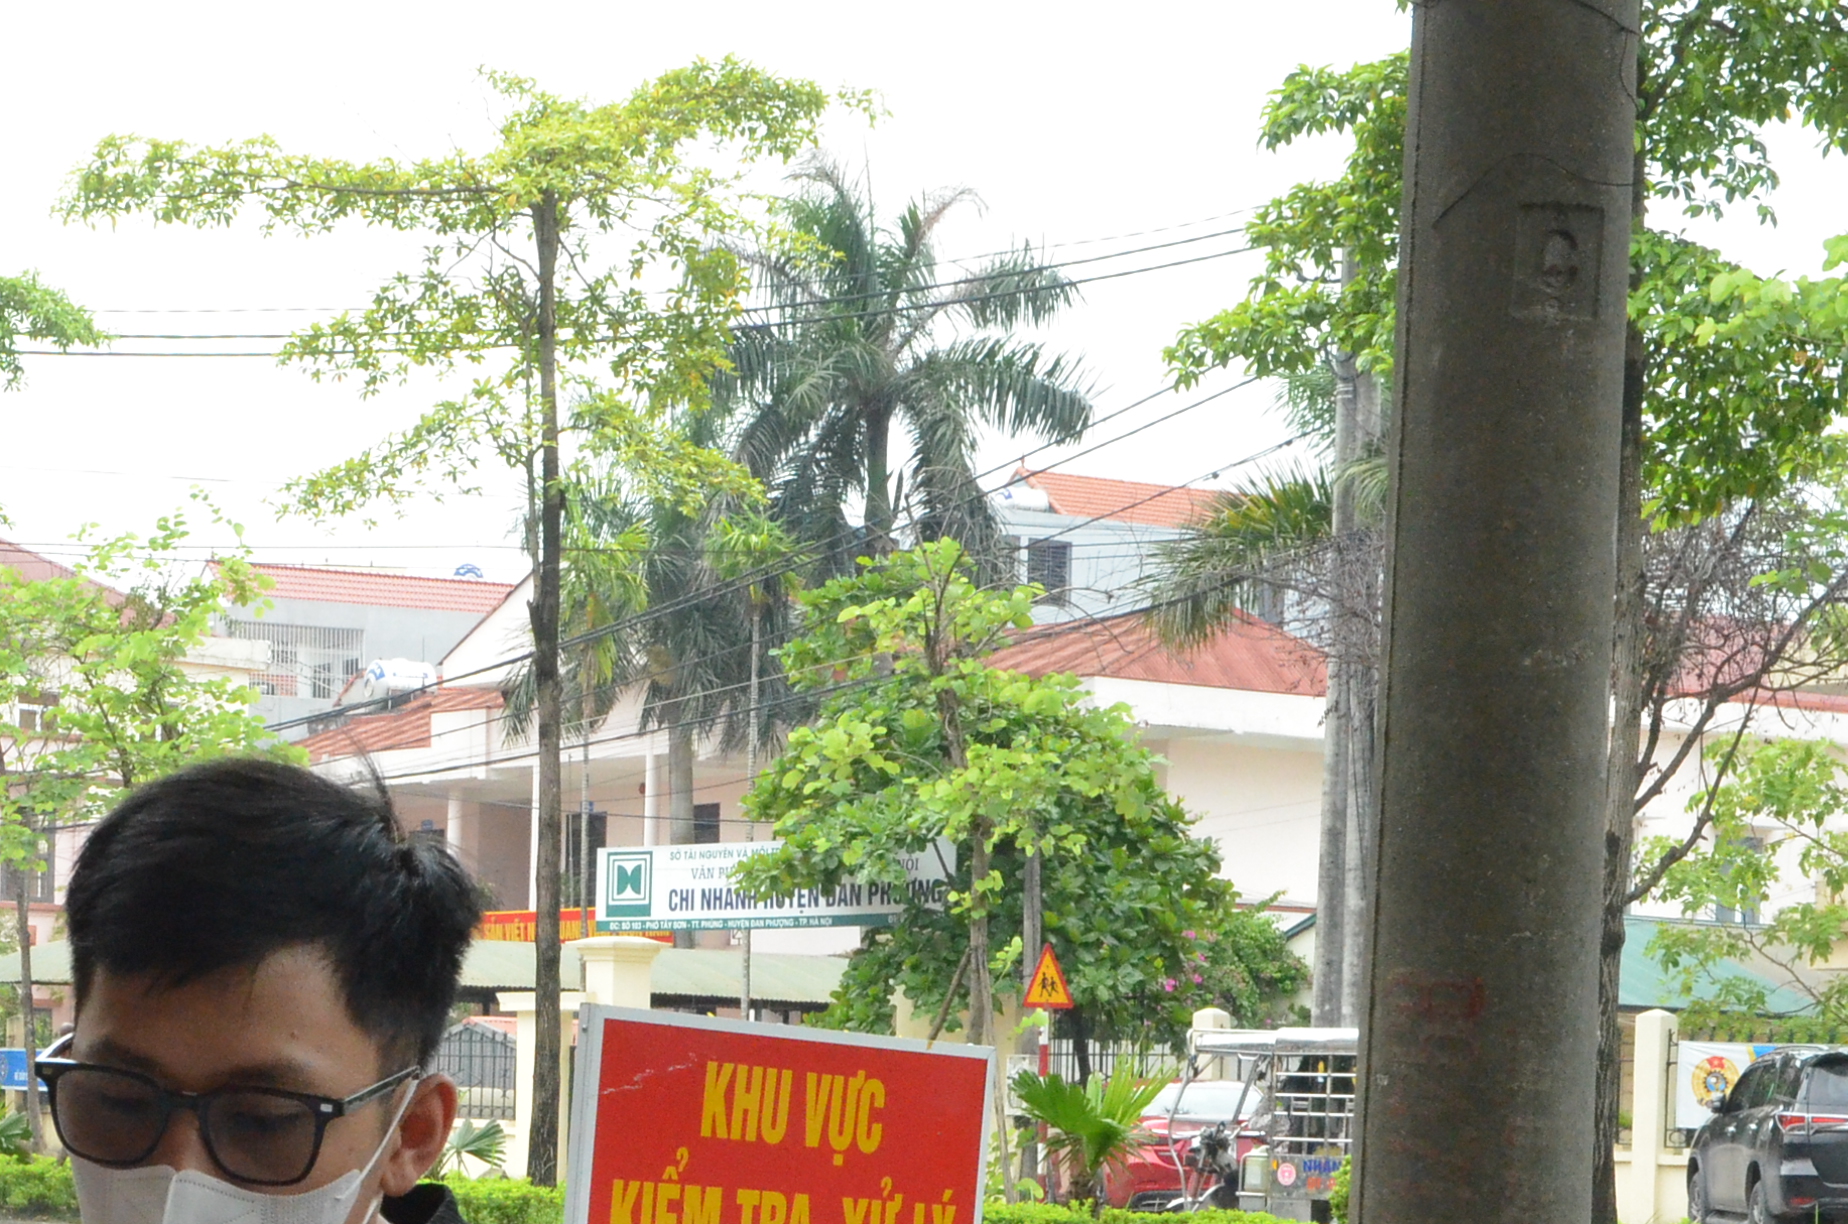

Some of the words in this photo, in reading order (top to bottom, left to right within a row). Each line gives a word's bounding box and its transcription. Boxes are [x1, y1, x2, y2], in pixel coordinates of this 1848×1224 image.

[669, 888, 695, 912] CHI
[700, 1061, 793, 1144] KHU
[805, 1070, 886, 1166] VỰC
